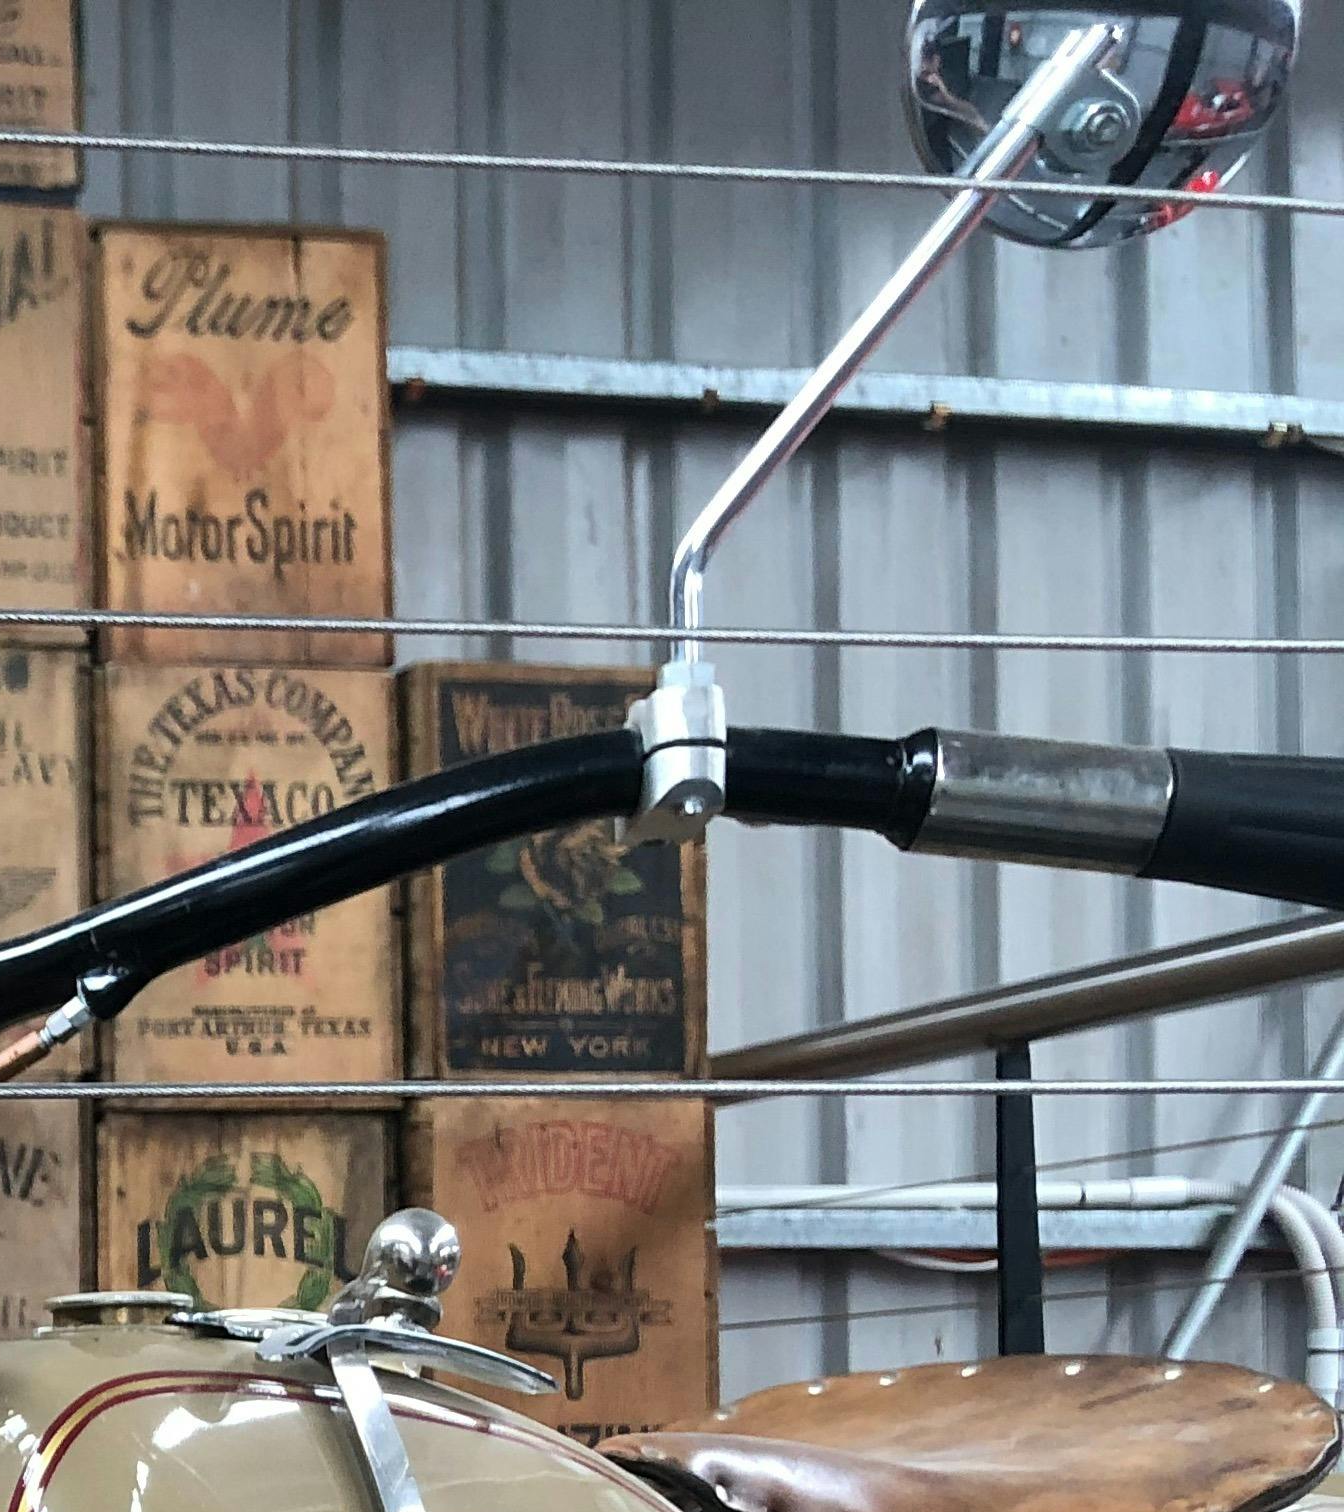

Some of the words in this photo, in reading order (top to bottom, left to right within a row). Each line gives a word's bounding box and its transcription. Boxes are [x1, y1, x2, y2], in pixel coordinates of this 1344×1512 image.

[125, 246, 356, 346] Plume
[149, 670, 257, 748] TEXAS
[127, 742, 174, 828] THE
[170, 778, 336, 827] TEXACO
[203, 948, 308, 977] SPIRIT
[479, 1034, 549, 1056] NEW
[136, 1198, 359, 1290] LAUREL
